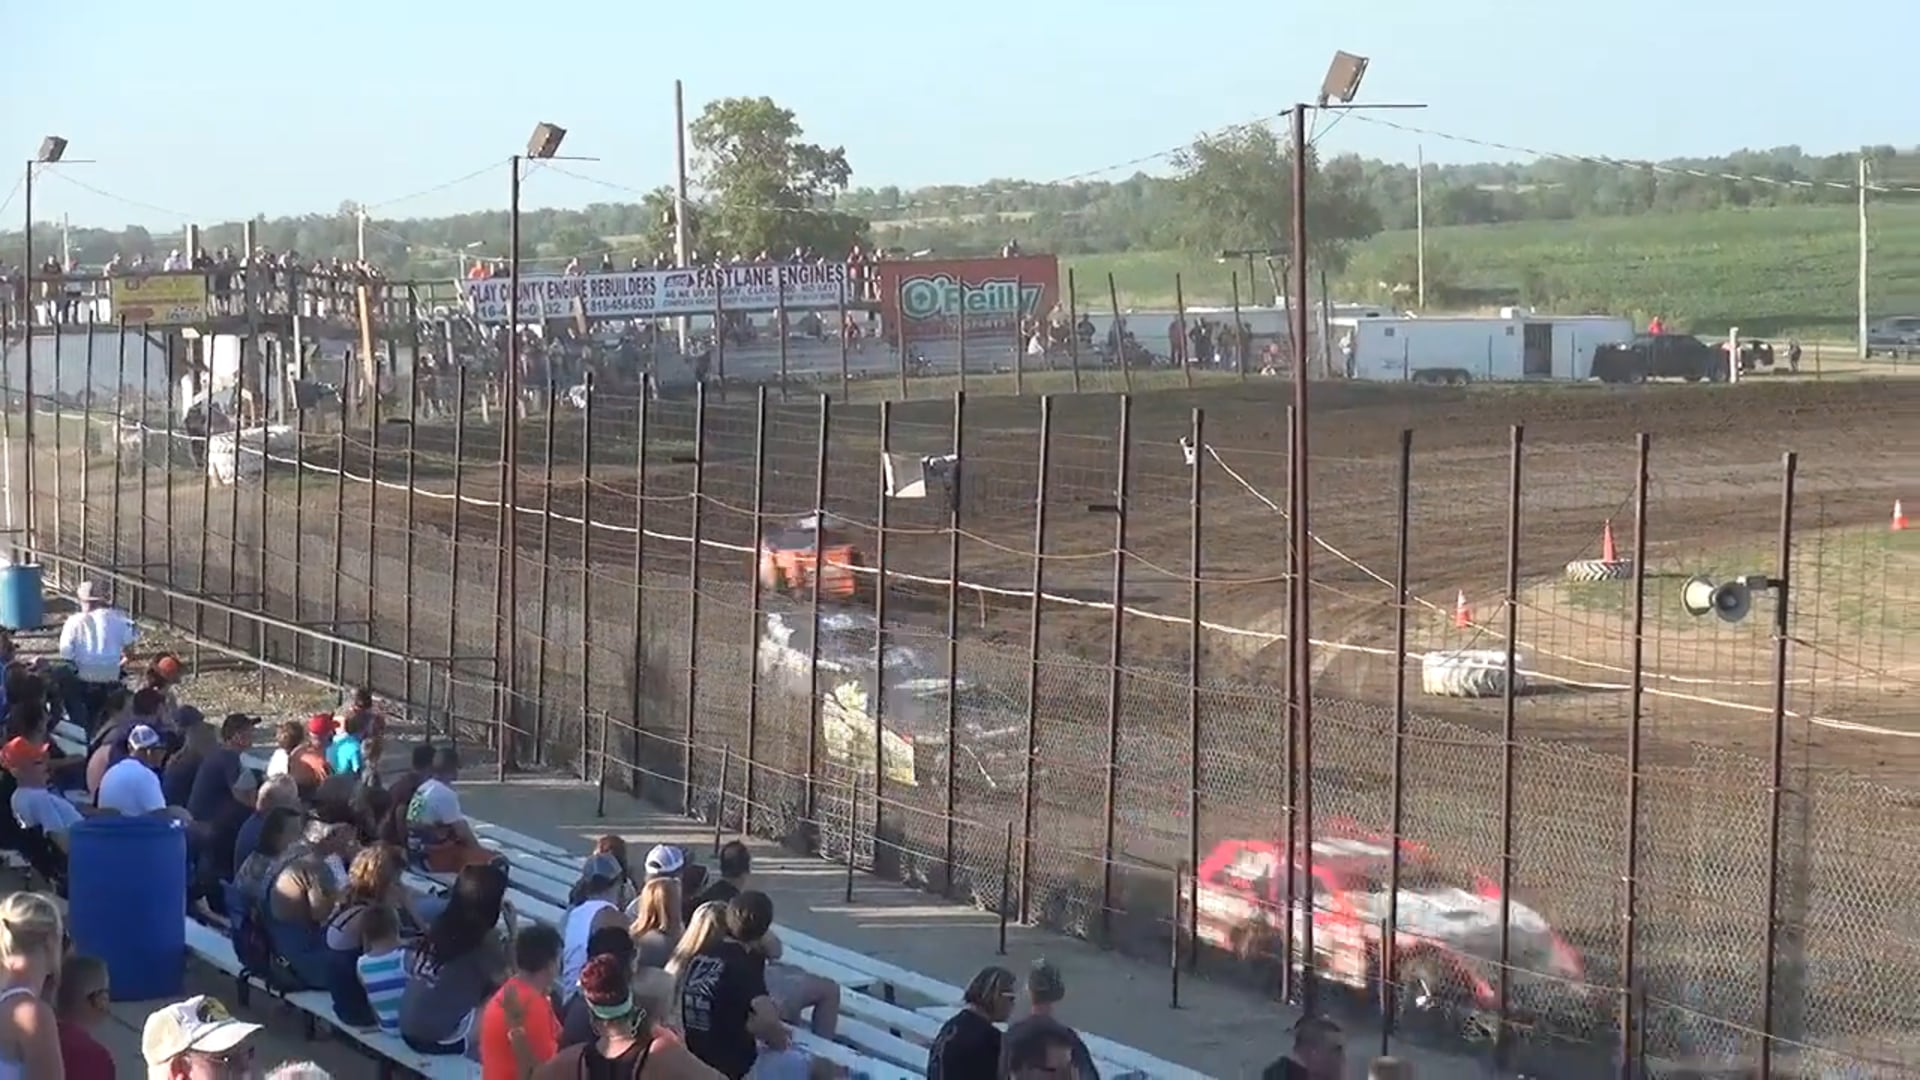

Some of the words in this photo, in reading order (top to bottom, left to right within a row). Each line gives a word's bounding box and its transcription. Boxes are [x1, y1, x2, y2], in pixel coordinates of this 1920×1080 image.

[469, 283, 498, 303] CLAY
[500, 281, 545, 302] CNTY
[547, 279, 588, 299] ENGINE
[590, 276, 657, 297] REBUILDERS
[697, 267, 773, 288] FASTLANE
[779, 264, 845, 285] ENGINES
[901, 276, 1041, 317] O'Reilly
